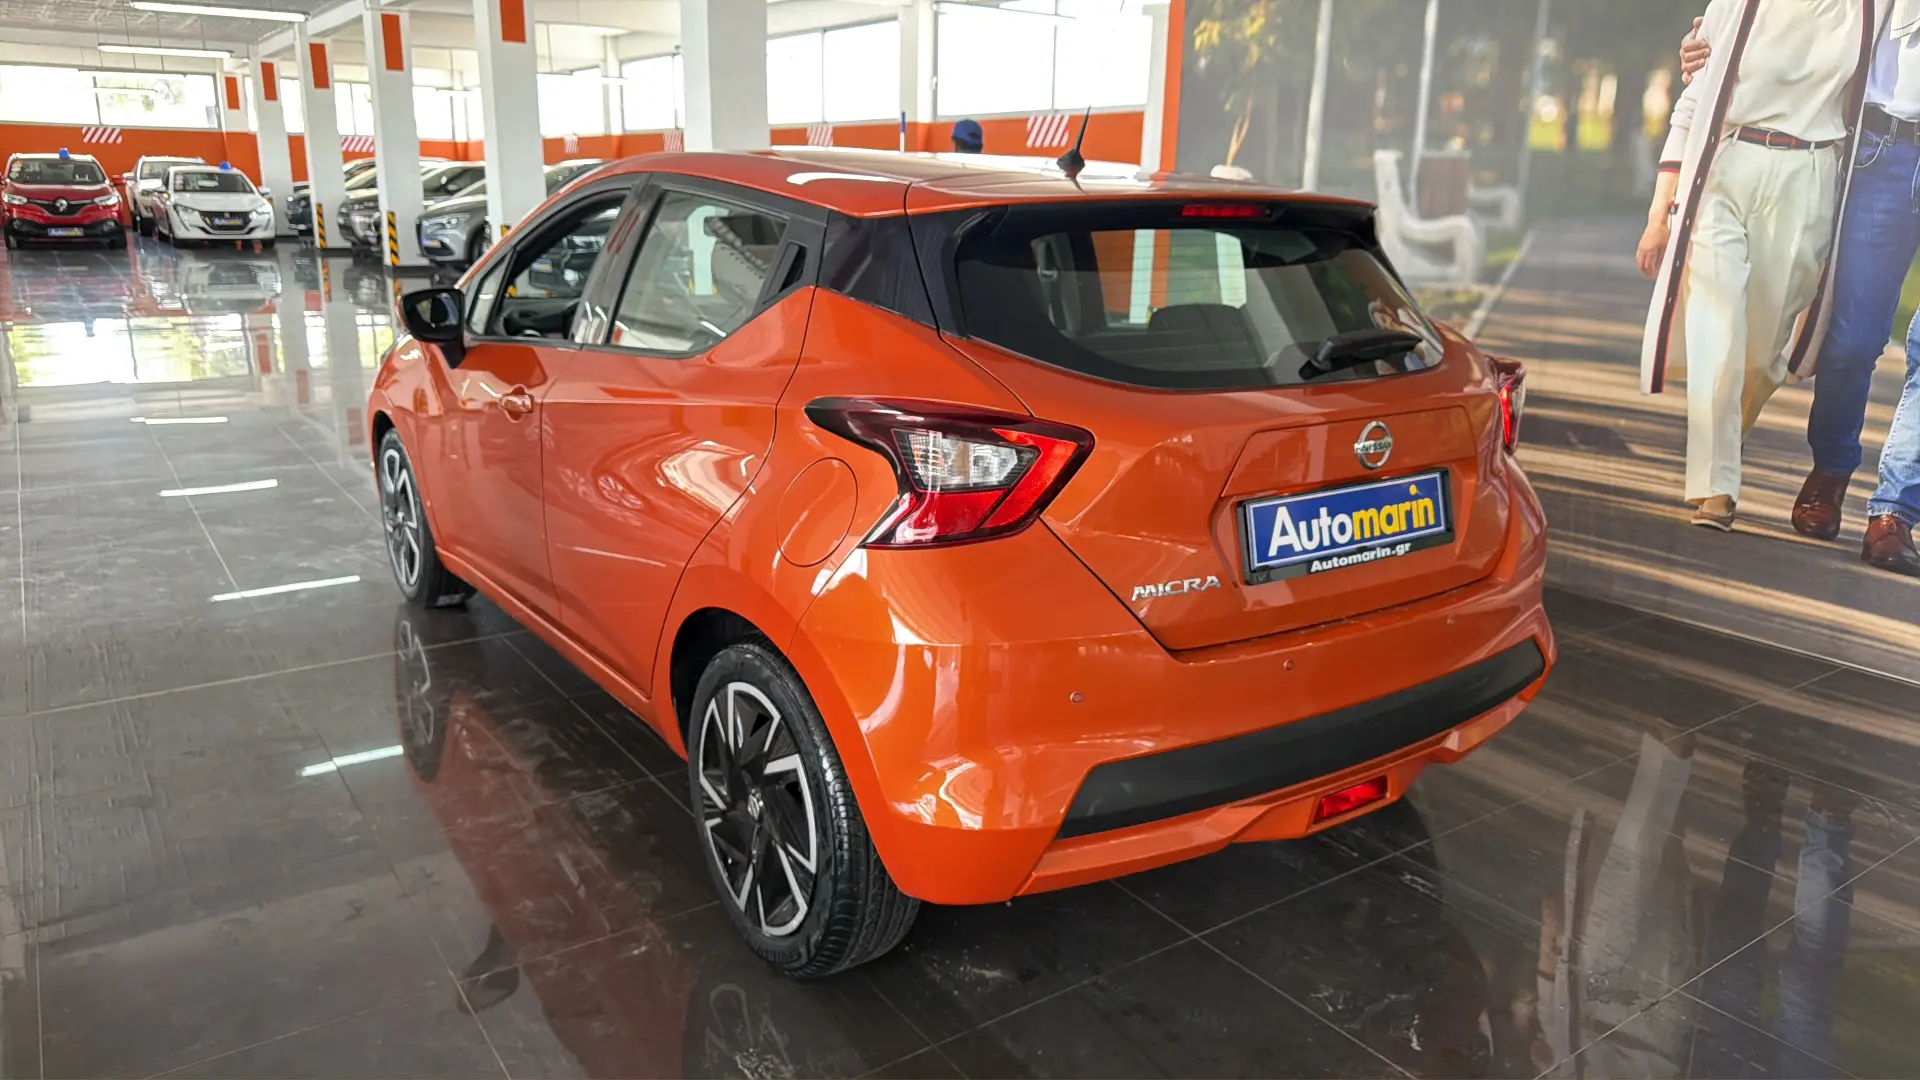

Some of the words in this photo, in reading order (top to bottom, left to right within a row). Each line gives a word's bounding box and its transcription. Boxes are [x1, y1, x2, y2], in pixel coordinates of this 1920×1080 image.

[1268, 484, 1435, 557] Automarin
[1310, 541, 1412, 573] Automarin.gr
[1131, 575, 1221, 601] MICRA
